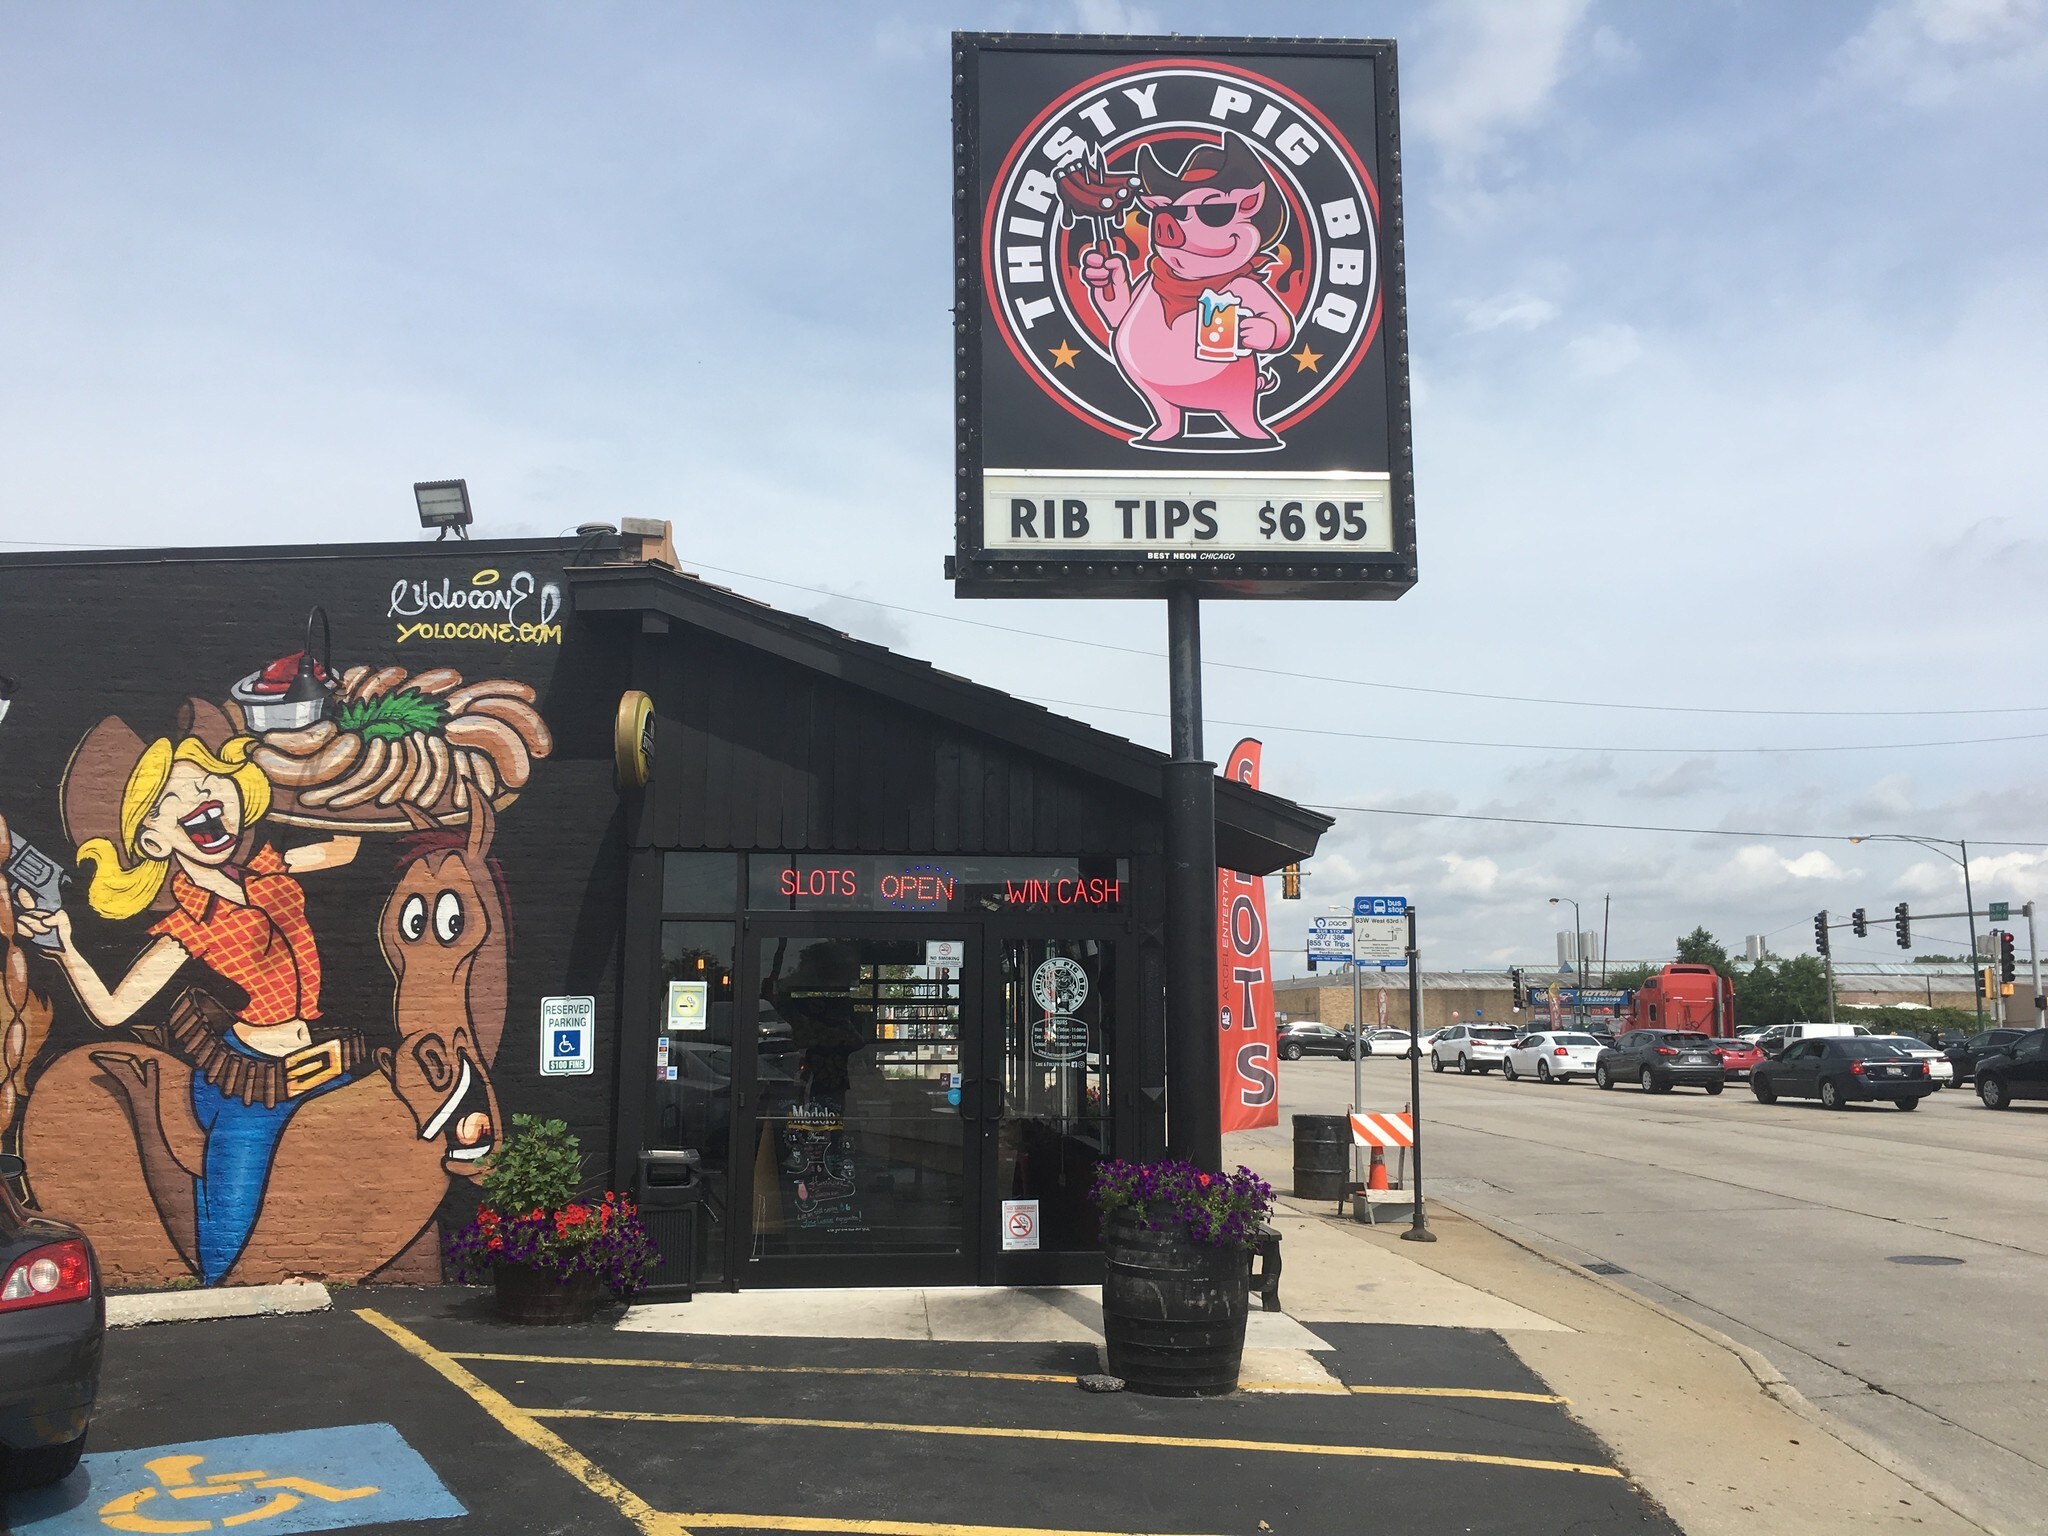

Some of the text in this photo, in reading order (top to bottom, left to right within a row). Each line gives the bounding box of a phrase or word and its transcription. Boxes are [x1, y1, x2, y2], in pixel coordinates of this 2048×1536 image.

[1007, 83, 1365, 335] THIRSTY PIG BBQ
[1010, 499, 1091, 540] RIB
[1114, 499, 1219, 541] TIPS
[1147, 552, 1236, 561] BEST NEON CHICAGO
[396, 622, 562, 646] YOLOCONE.COM
[781, 869, 856, 896] SLOTS
[881, 875, 954, 900] OPEN
[1006, 878, 1120, 904] WIN CASH
[1334, 940, 1350, 949] Trips
[1035, 961, 1057, 998] THIRSY
[1064, 961, 1079, 974] PIG
[545, 1004, 590, 1015] RESERVED
[1222, 1011, 1230, 1025] AE
[548, 1017, 587, 1028] PARKING
[550, 1060, 584, 1070] $100 FINE
[792, 1104, 837, 1125] Modelo
